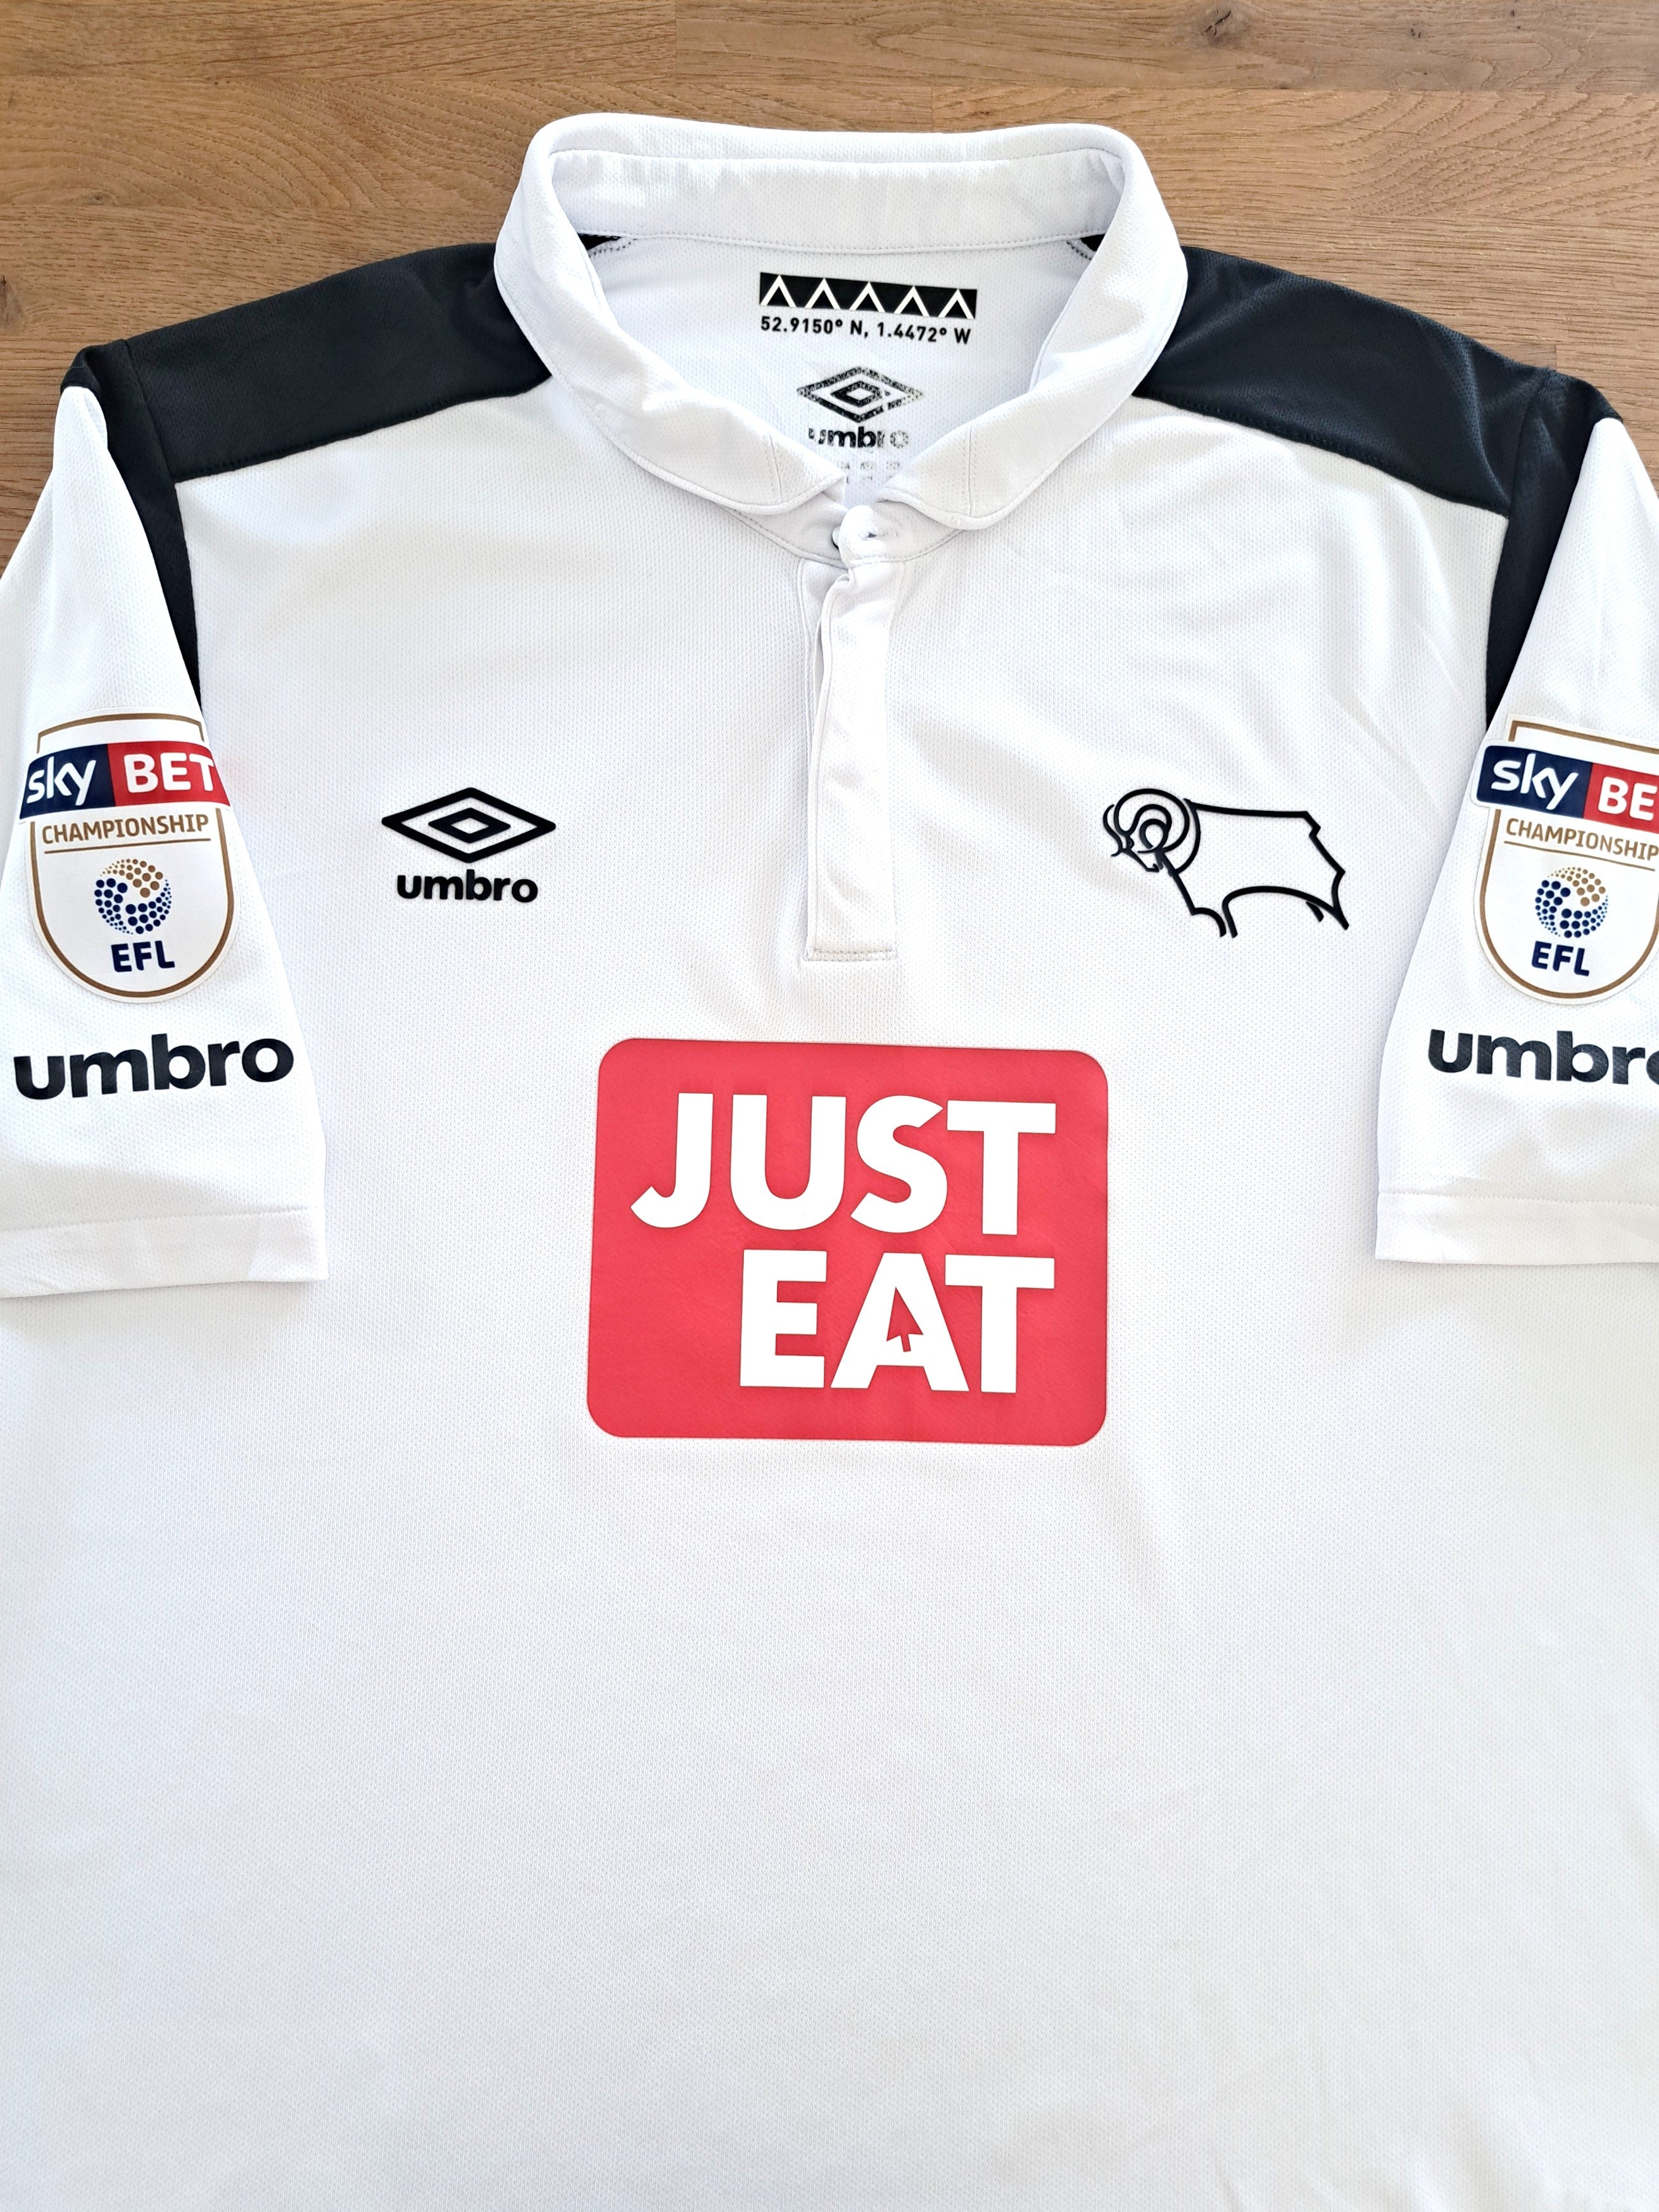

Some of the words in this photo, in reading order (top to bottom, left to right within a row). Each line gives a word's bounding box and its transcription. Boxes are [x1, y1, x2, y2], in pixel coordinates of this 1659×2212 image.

[760, 315, 843, 336] 52.9150°
[850, 319, 869, 339] N,
[877, 322, 947, 342] 1.4472°
[954, 327, 971, 345] W
[123, 752, 215, 794] BET
[1598, 776, 1659, 821] BE
[42, 814, 210, 845] CHAMPIONSHIP
[1506, 817, 1659, 862] CHAMPIONSHIP
[396, 868, 539, 903] umbro
[110, 940, 175, 973] EFL
[1531, 940, 1590, 977] EFL
[13, 1033, 294, 1100] umbro
[1428, 1029, 1659, 1085] umbr
[630, 1093, 1056, 1235] JUST
[740, 1249, 1055, 1393] EAT
